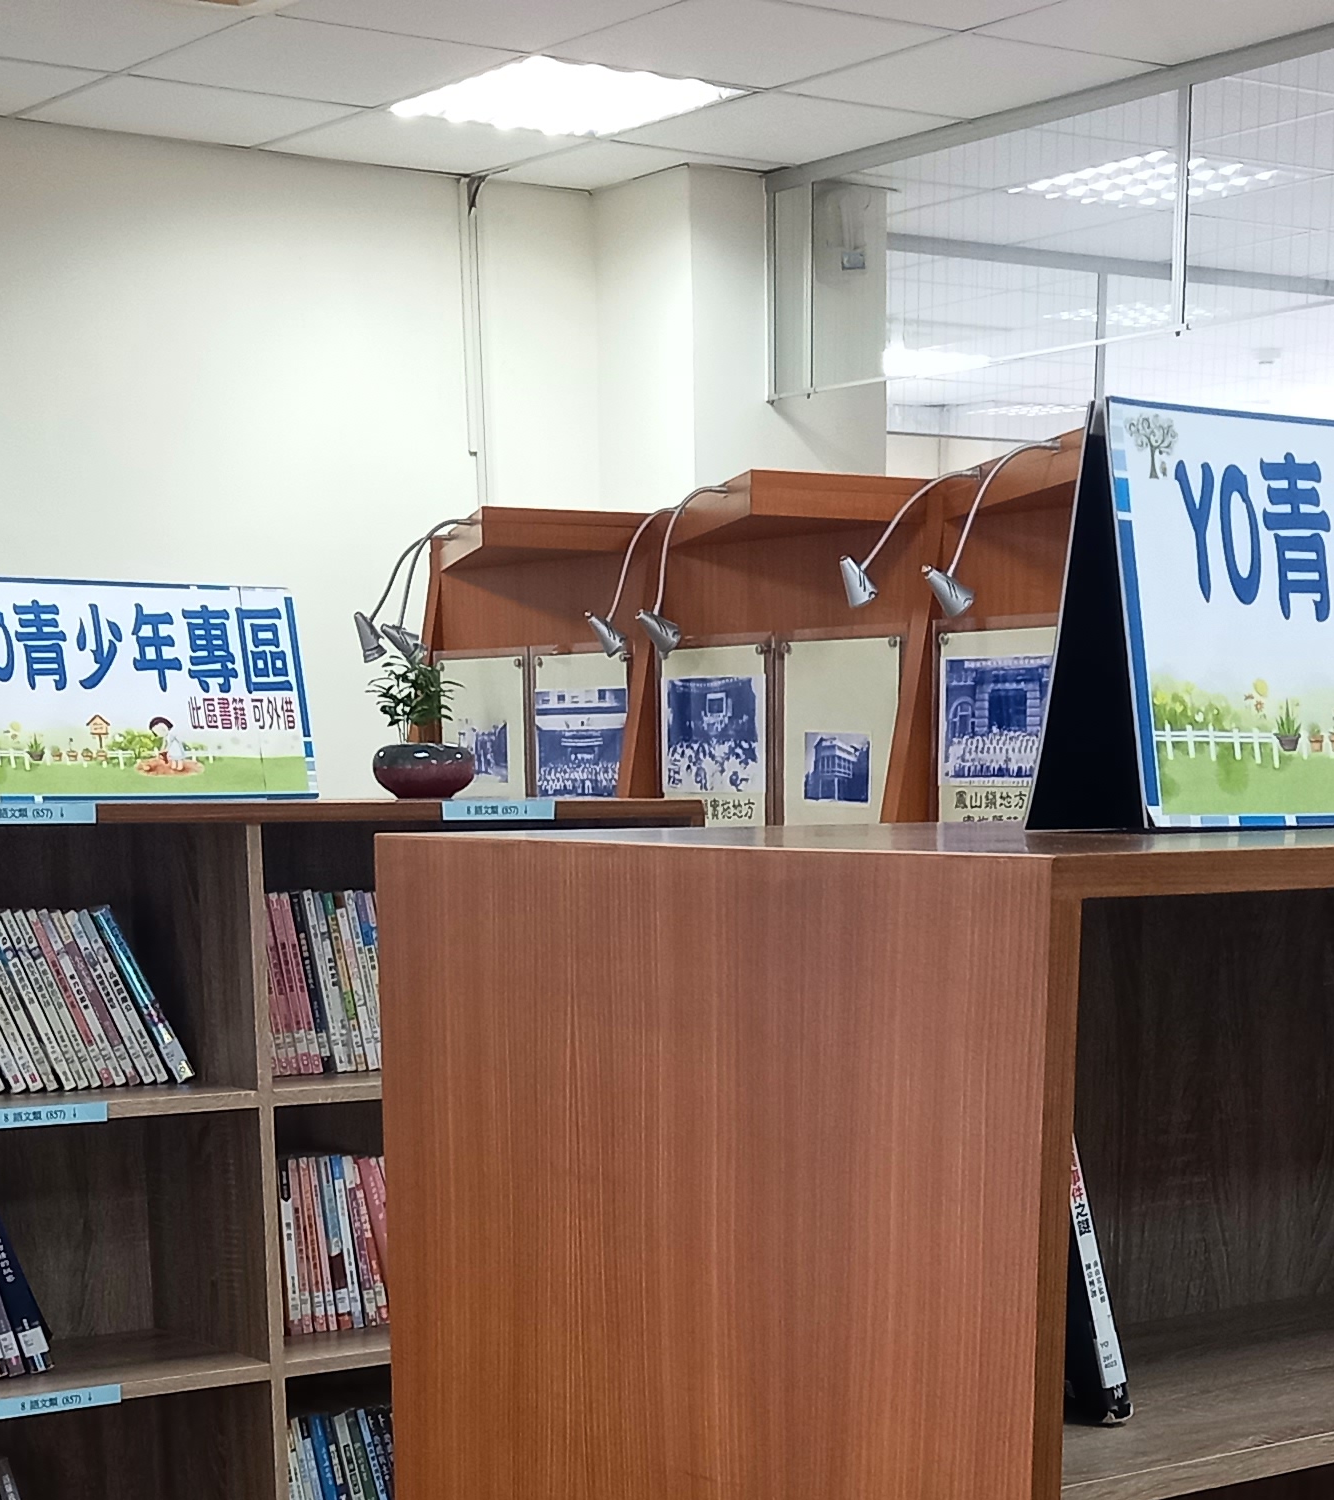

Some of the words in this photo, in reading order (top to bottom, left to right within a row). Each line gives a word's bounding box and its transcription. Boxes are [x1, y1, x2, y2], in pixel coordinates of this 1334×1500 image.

[189, 696, 247, 731] 此區書籍
[251, 697, 296, 731] 可外借
[704, 797, 755, 820] 實施地方
[13, 1110, 42, 1122] 語文類
[46, 1109, 66, 1120] (857)
[30, 1396, 58, 1410] 語文類
